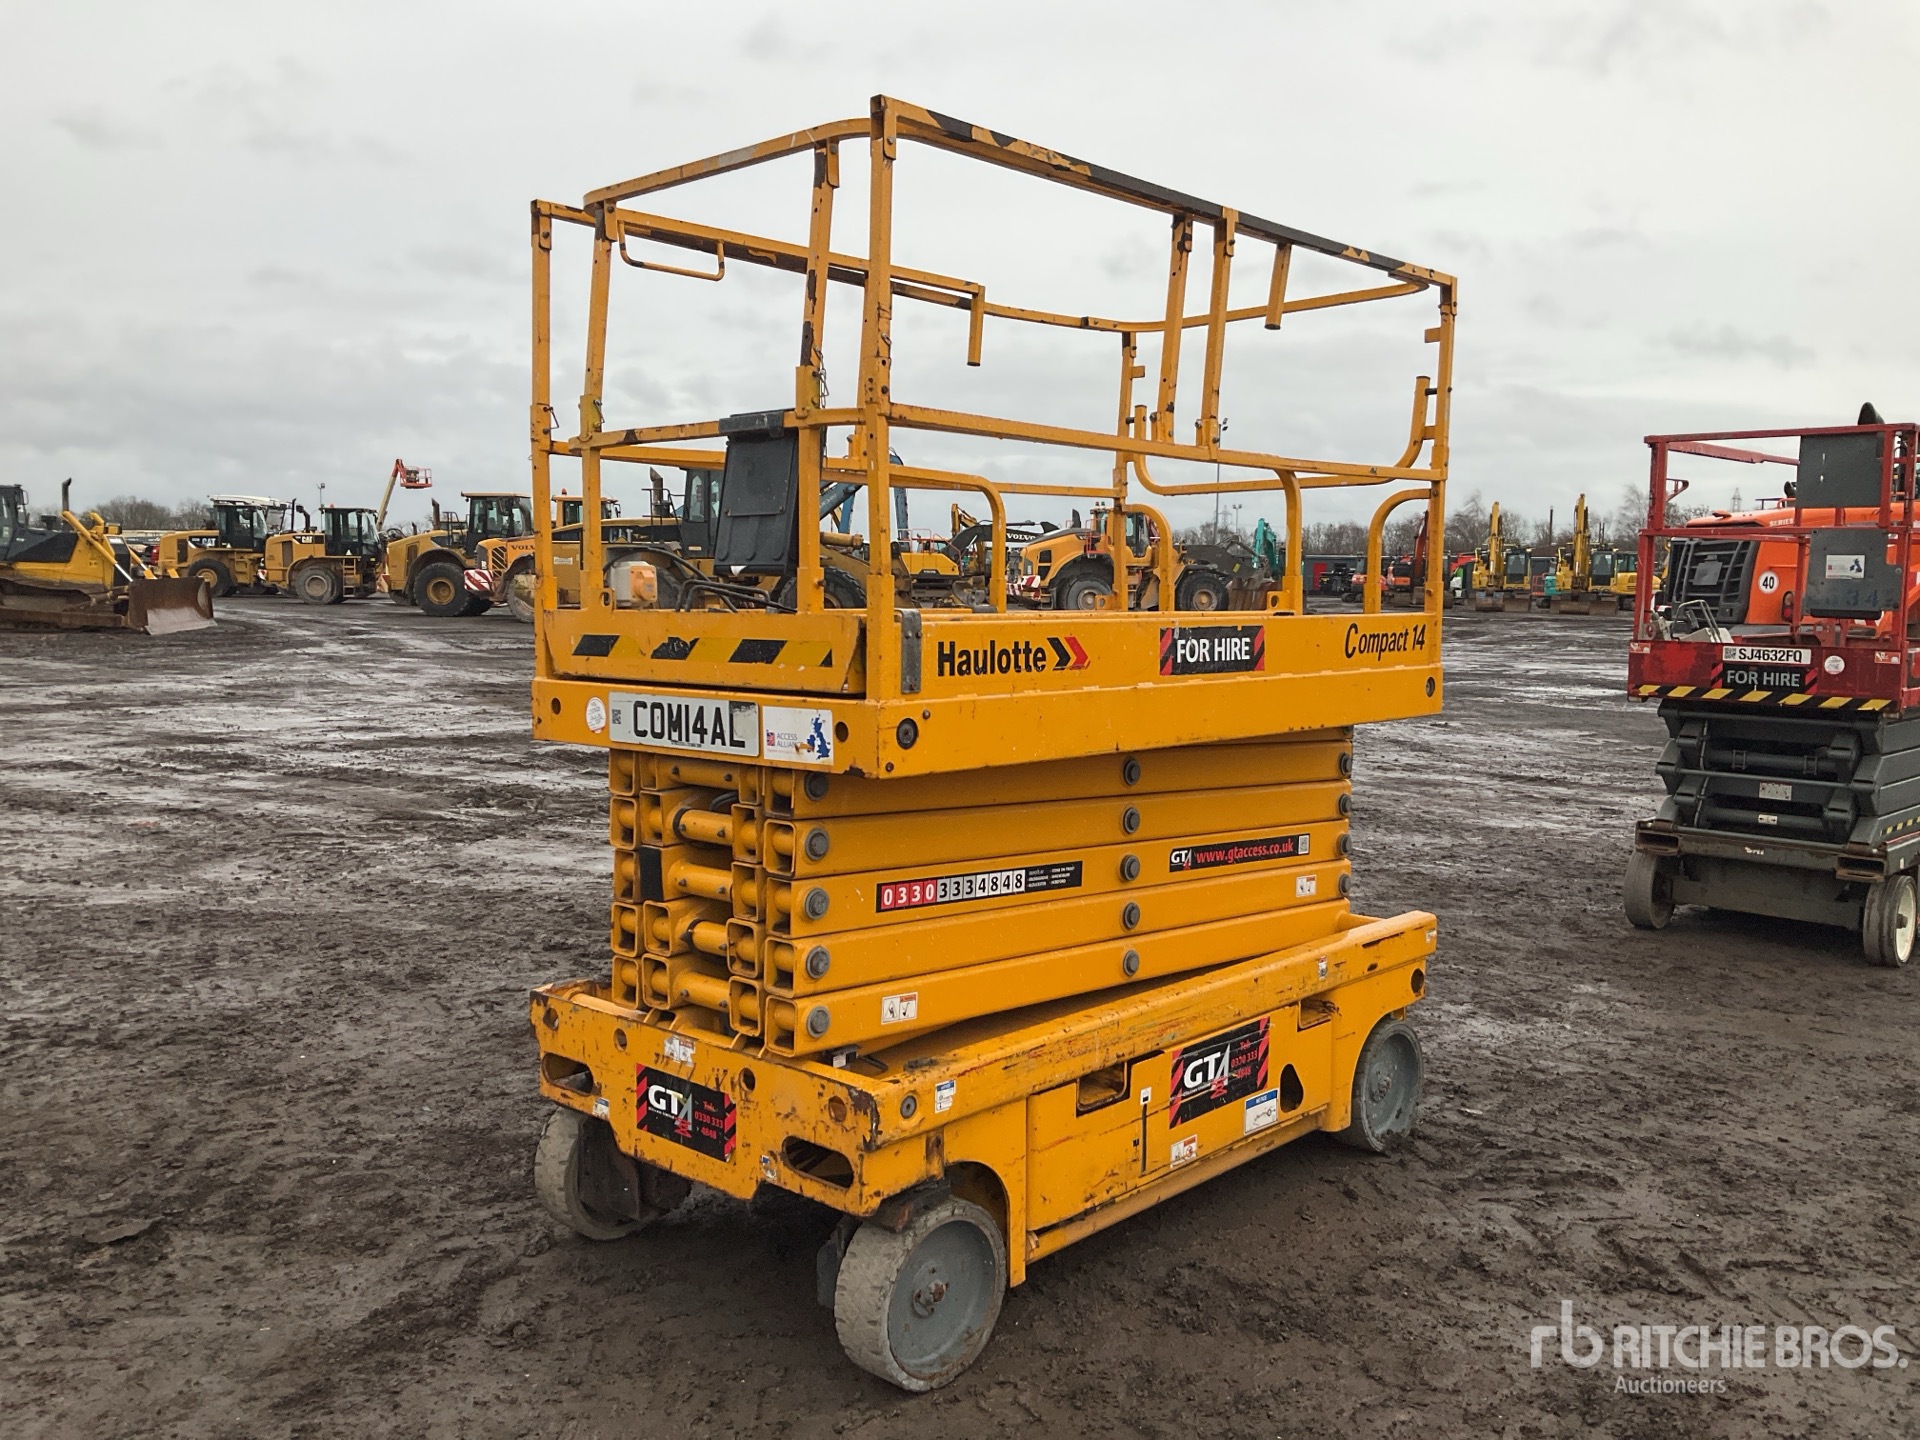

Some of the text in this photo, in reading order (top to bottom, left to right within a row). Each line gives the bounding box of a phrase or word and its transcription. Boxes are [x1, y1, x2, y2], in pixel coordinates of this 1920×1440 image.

[1769, 518, 1794, 527] SERIES
[202, 538, 216, 547] CAT
[1762, 576, 1775, 589] 40
[1176, 637, 1251, 663] FOR HIRE
[1345, 623, 1426, 661] Compact 14
[937, 639, 1047, 677] Haulotte
[1738, 648, 1802, 663] SJ4632FQ
[1726, 670, 1801, 687] FOR HIRE
[776, 732, 798, 741] ACCESS
[1196, 838, 1294, 864] www.gtaccess.co.uk
[694, 1111, 724, 1129] 0330 333
